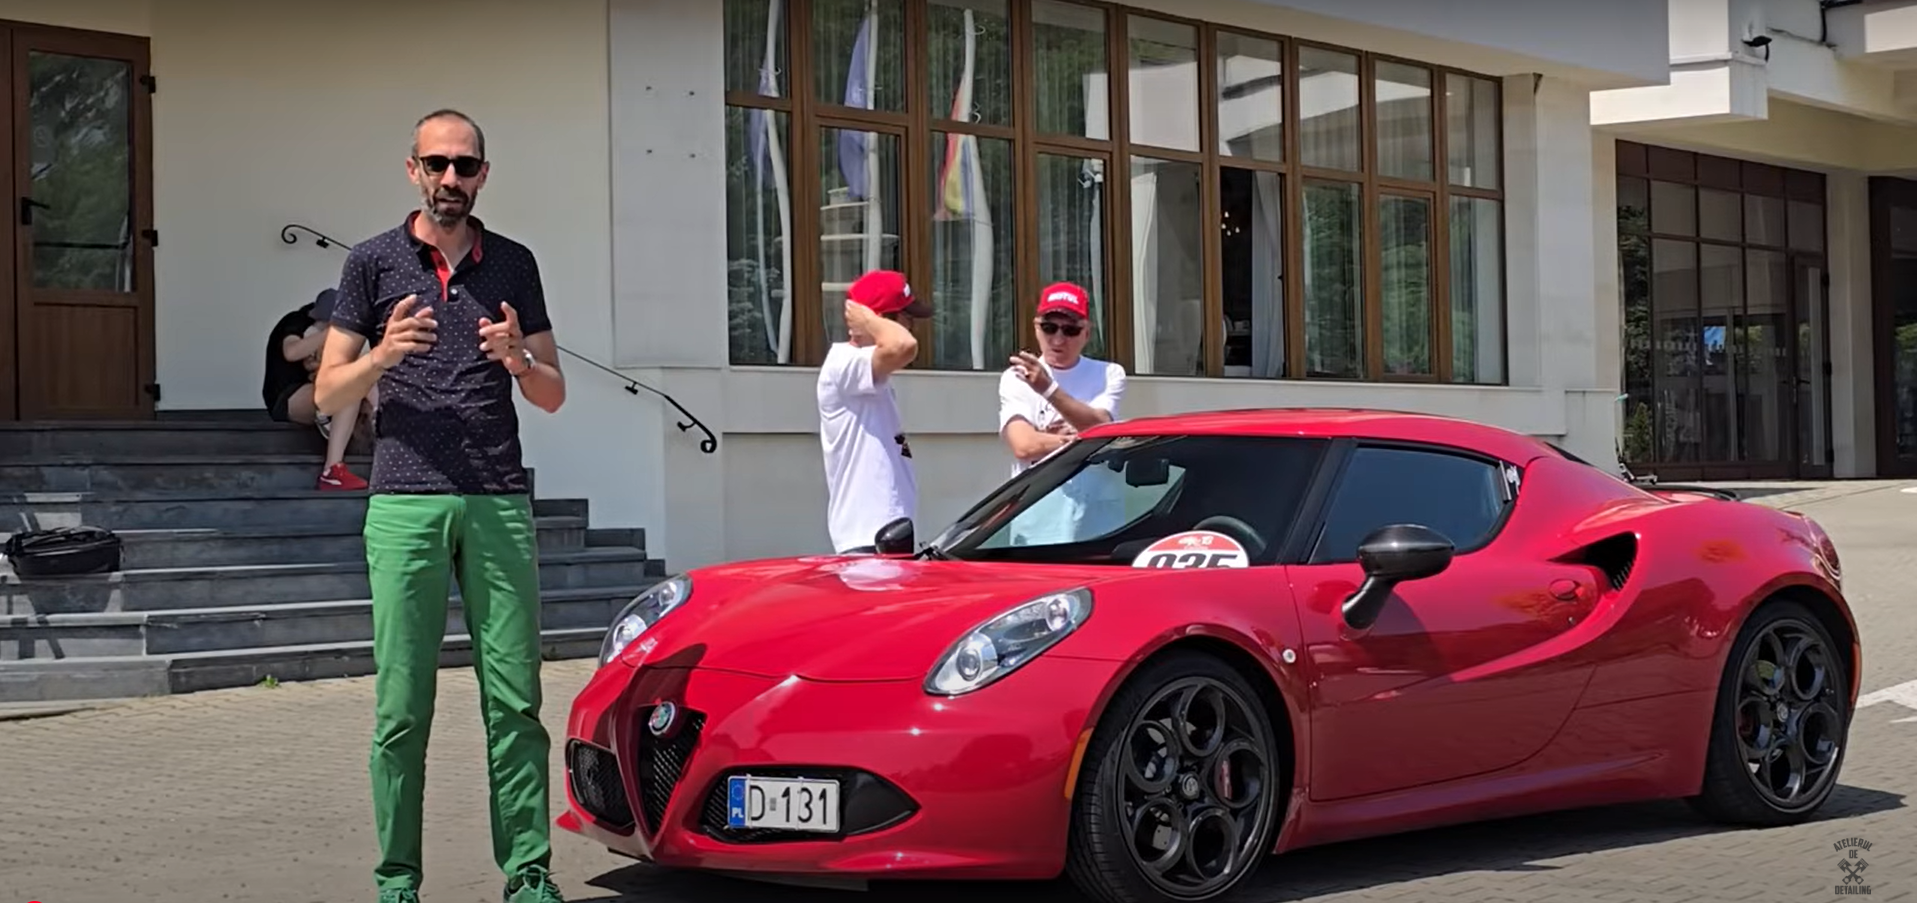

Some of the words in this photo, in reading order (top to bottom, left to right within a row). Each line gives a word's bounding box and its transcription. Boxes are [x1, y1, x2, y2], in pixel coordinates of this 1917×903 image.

[731, 807, 744, 818] PL
[749, 785, 765, 821] D
[781, 786, 827, 825] 131
